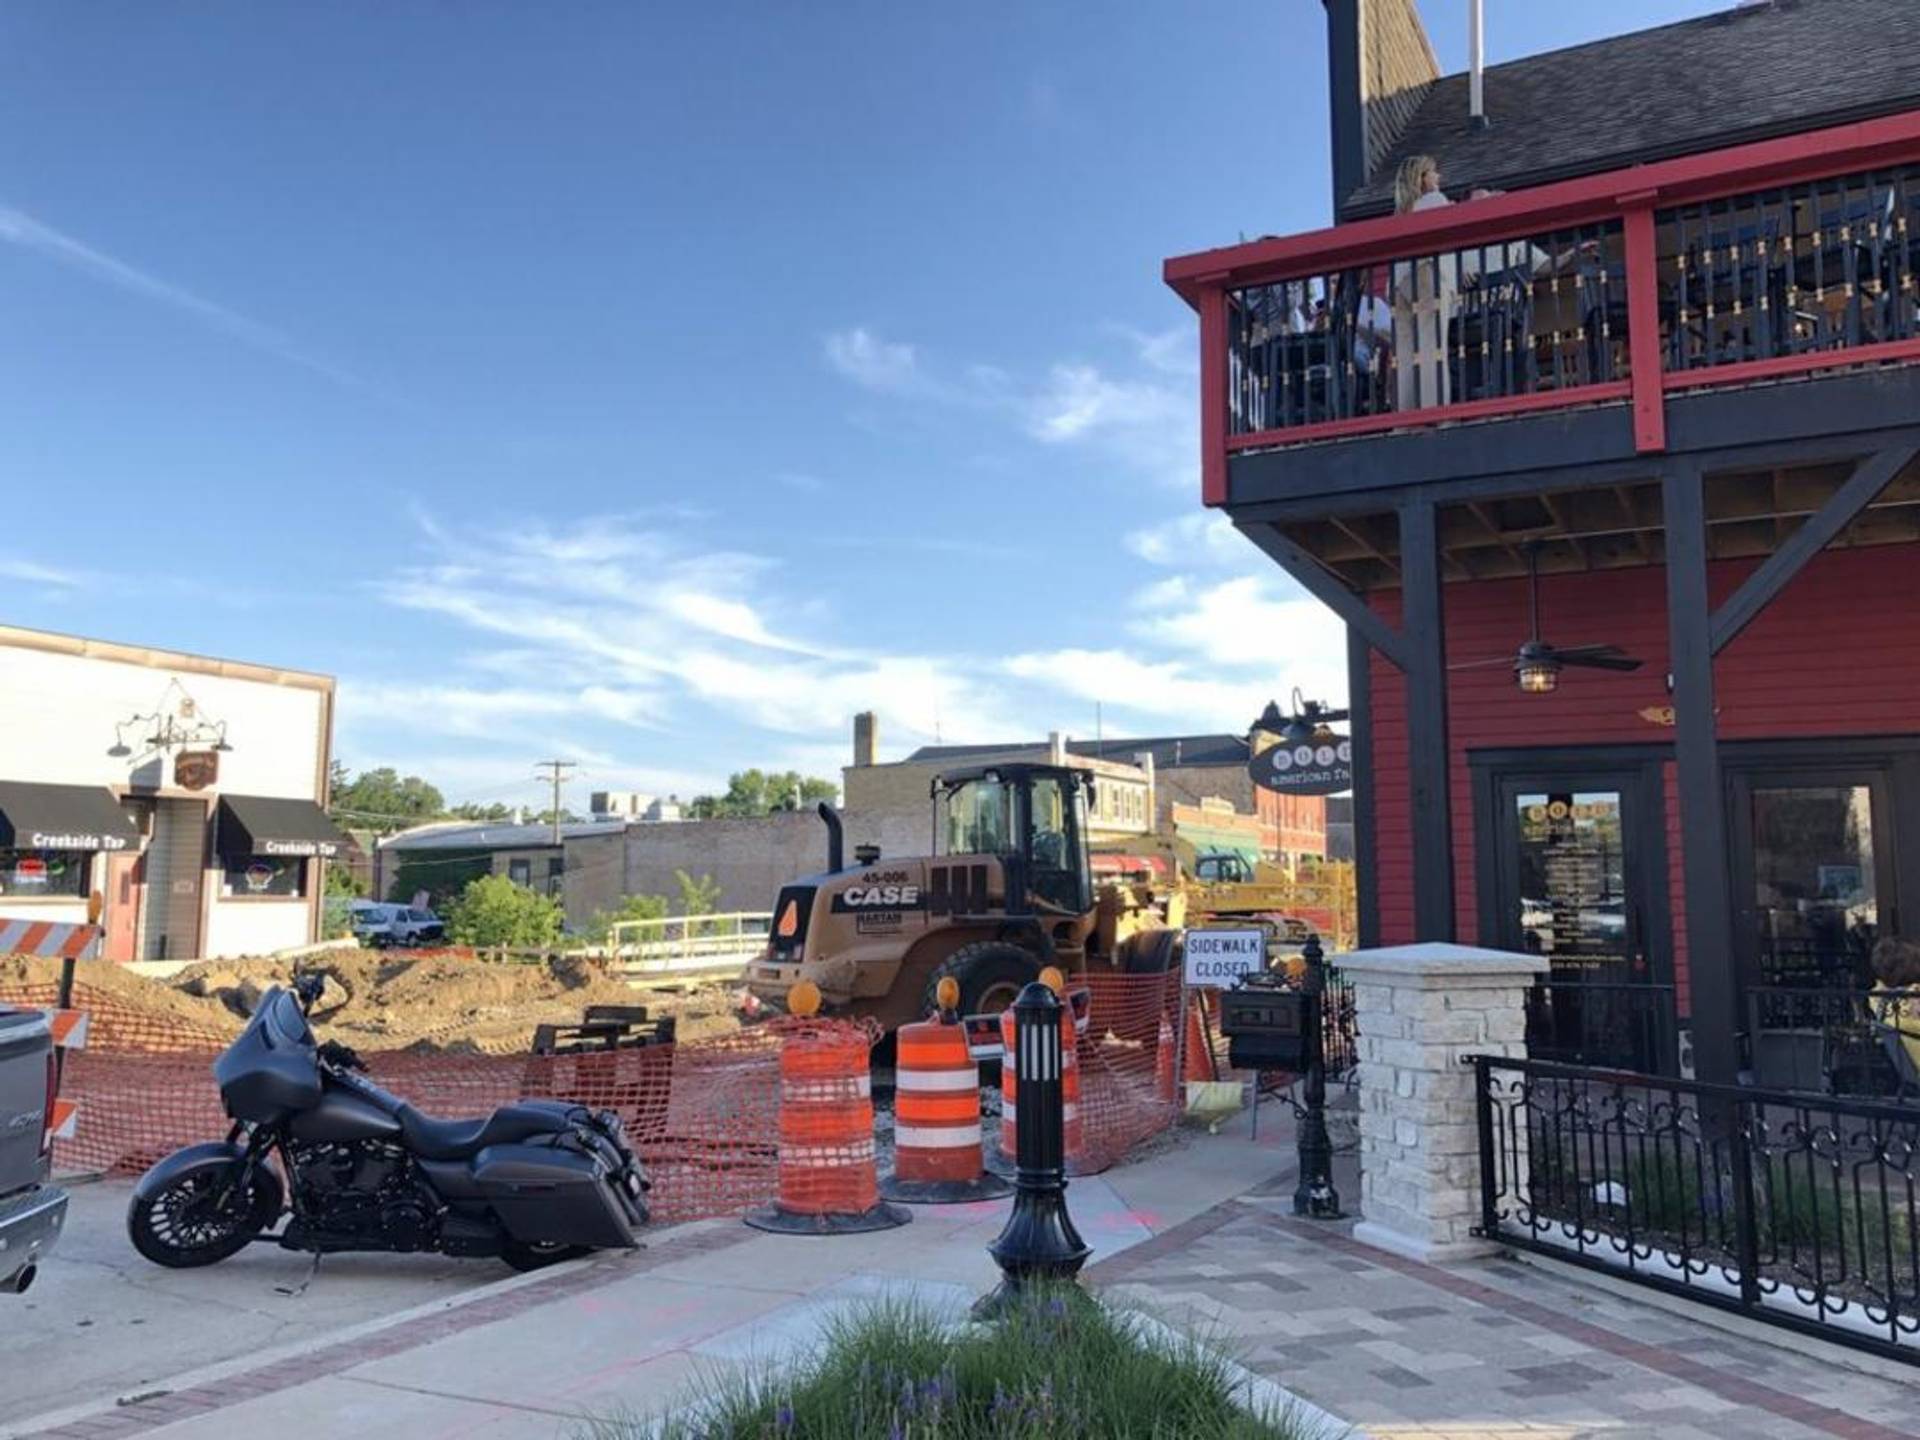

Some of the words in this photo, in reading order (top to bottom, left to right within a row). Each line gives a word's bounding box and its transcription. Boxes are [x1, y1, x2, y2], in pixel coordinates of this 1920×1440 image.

[32, 832, 99, 850] Creekside
[265, 840, 316, 855] Creekside
[843, 886, 919, 906] CASE
[1190, 939, 1258, 954] SIDEWALK
[1196, 962, 1250, 977] CLOSED
